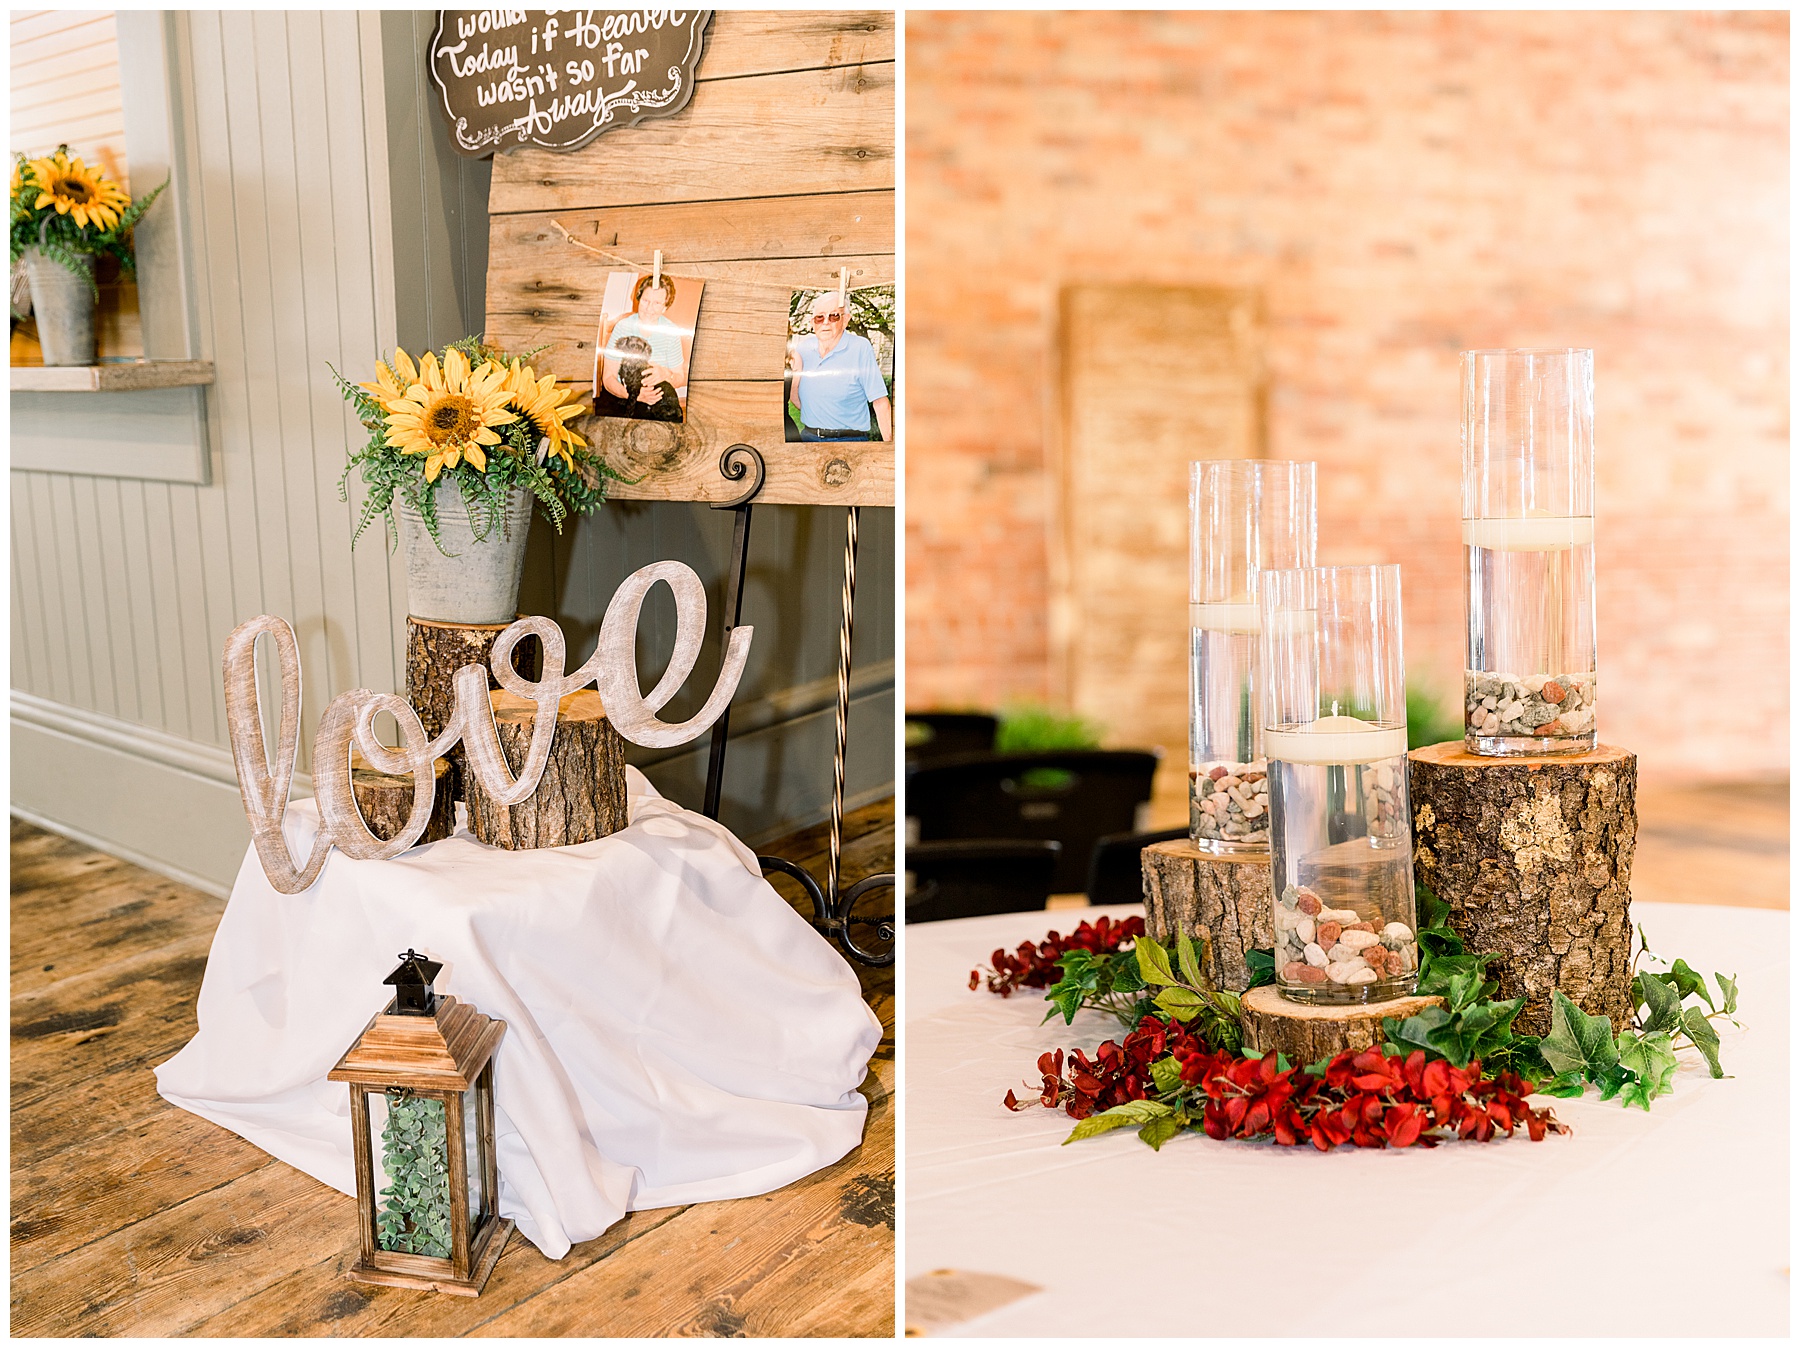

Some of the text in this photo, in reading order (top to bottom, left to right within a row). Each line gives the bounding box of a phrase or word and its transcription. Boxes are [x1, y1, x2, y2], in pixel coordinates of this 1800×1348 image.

[437, 10, 686, 82] Today if Heaven
[477, 63, 558, 107] wasn't
[566, 60, 595, 86] so
[514, 80, 637, 135] Away
[223, 560, 753, 894] love
